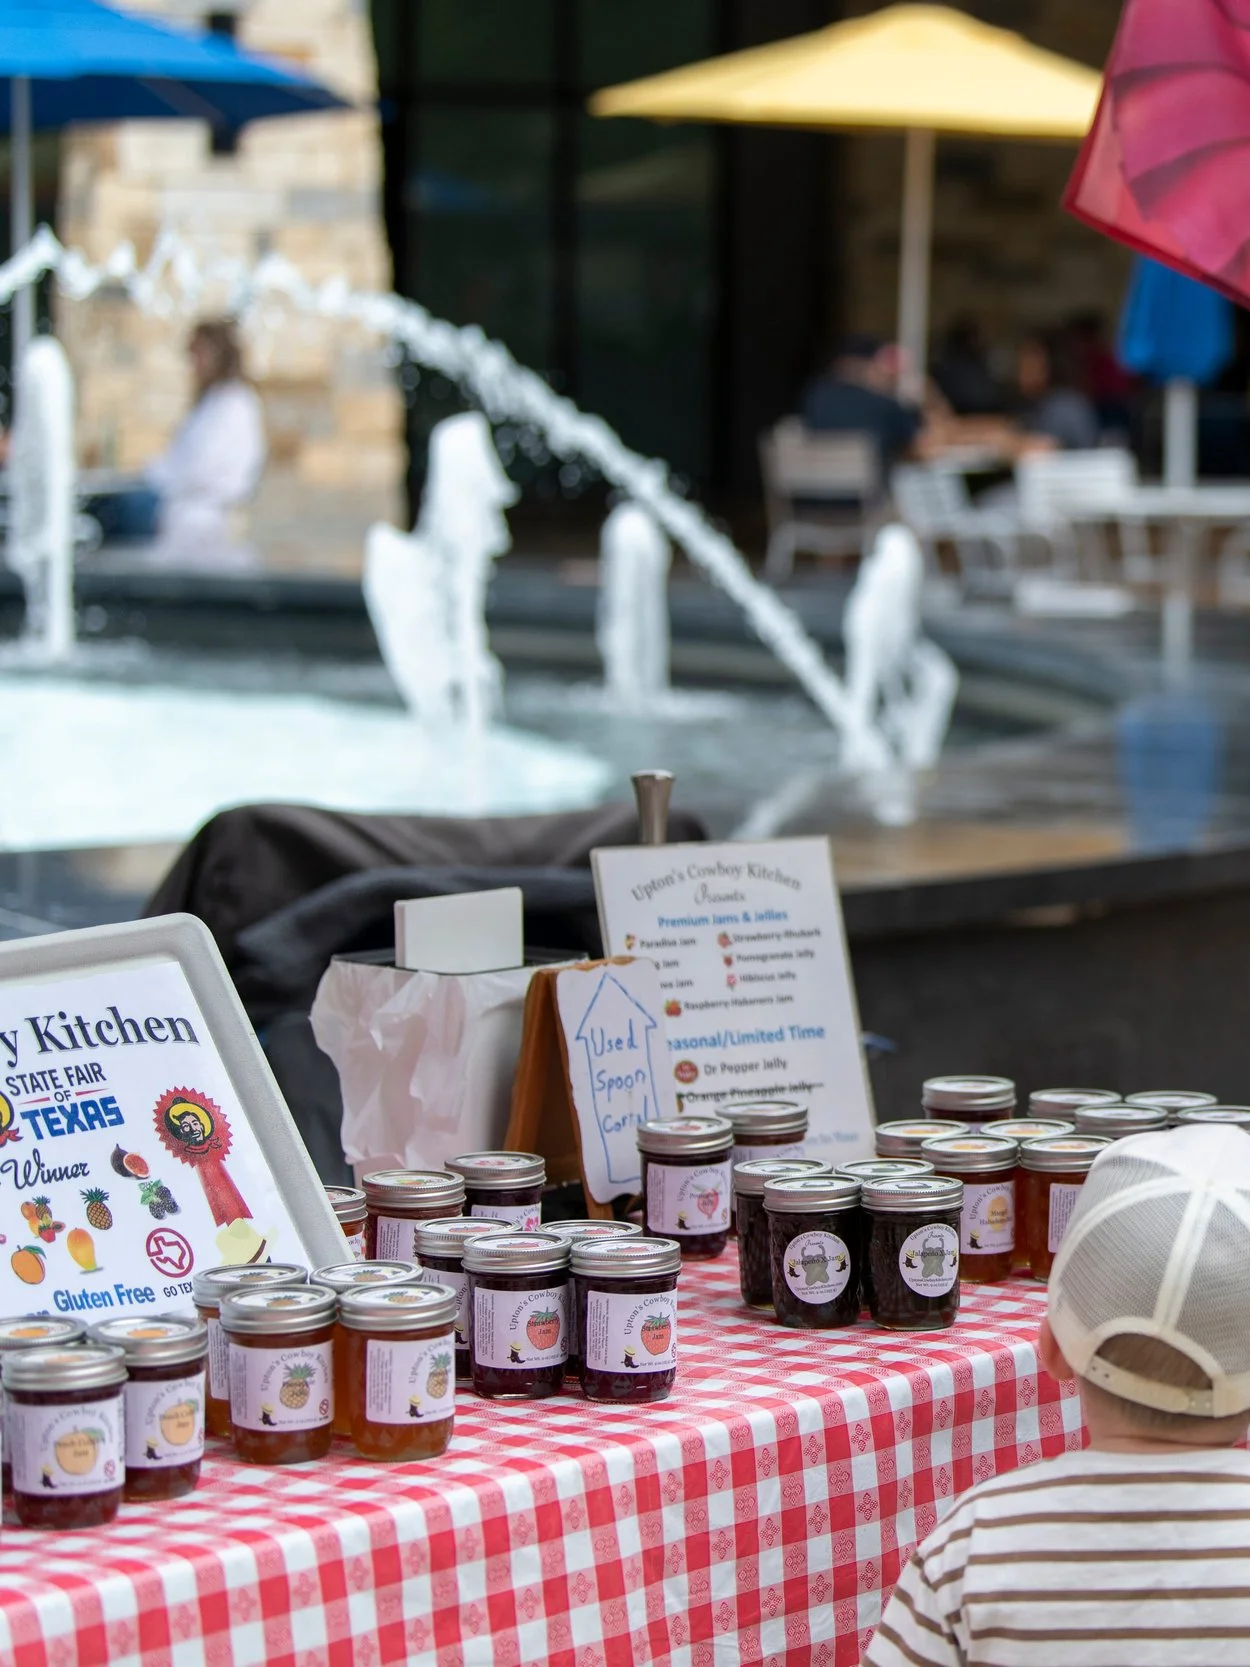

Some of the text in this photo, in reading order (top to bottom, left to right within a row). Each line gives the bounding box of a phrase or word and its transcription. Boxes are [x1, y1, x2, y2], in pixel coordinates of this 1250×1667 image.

[631, 862, 802, 902] Upton's Cowboy Kitchen
[657, 909, 788, 929] Premium Jams & Jellies
[640, 937, 677, 949] Paradise
[24, 1006, 201, 1055] Kitchen
[590, 1018, 638, 1057] Used
[789, 1024, 826, 1041] Time
[5, 1062, 107, 1097] STATE FAIR
[704, 1064, 717, 1076] Dr
[721, 1061, 760, 1076] Pepper
[762, 1057, 788, 1073] Jelly
[53, 1089, 72, 1103] OF
[595, 1069, 645, 1102] Spoon
[687, 1080, 813, 1103] Orange Pineapple Jelly
[19, 1095, 125, 1141] TEXAS
[0, 1148, 90, 1190] Winner
[969, 1193, 987, 1220] Upton's
[803, 1231, 823, 1240] Cowboy
[927, 1224, 945, 1232] Cowboy
[53, 1283, 156, 1312] Gluten Free
[163, 1281, 193, 1298] GO TEX
[509, 1300, 529, 1331] Upton's
[527, 1289, 559, 1303] Cowboy
[623, 1305, 644, 1336] Upton's
[643, 1294, 669, 1308] Cowboy
[537, 1327, 552, 1336] Jam
[651, 1332, 665, 1341] Jam
[260, 1359, 281, 1392] Upton's
[280, 1348, 315, 1362] Cowboy
[408, 1350, 428, 1385] Upton's
[58, 1406, 97, 1421] Cowboy
